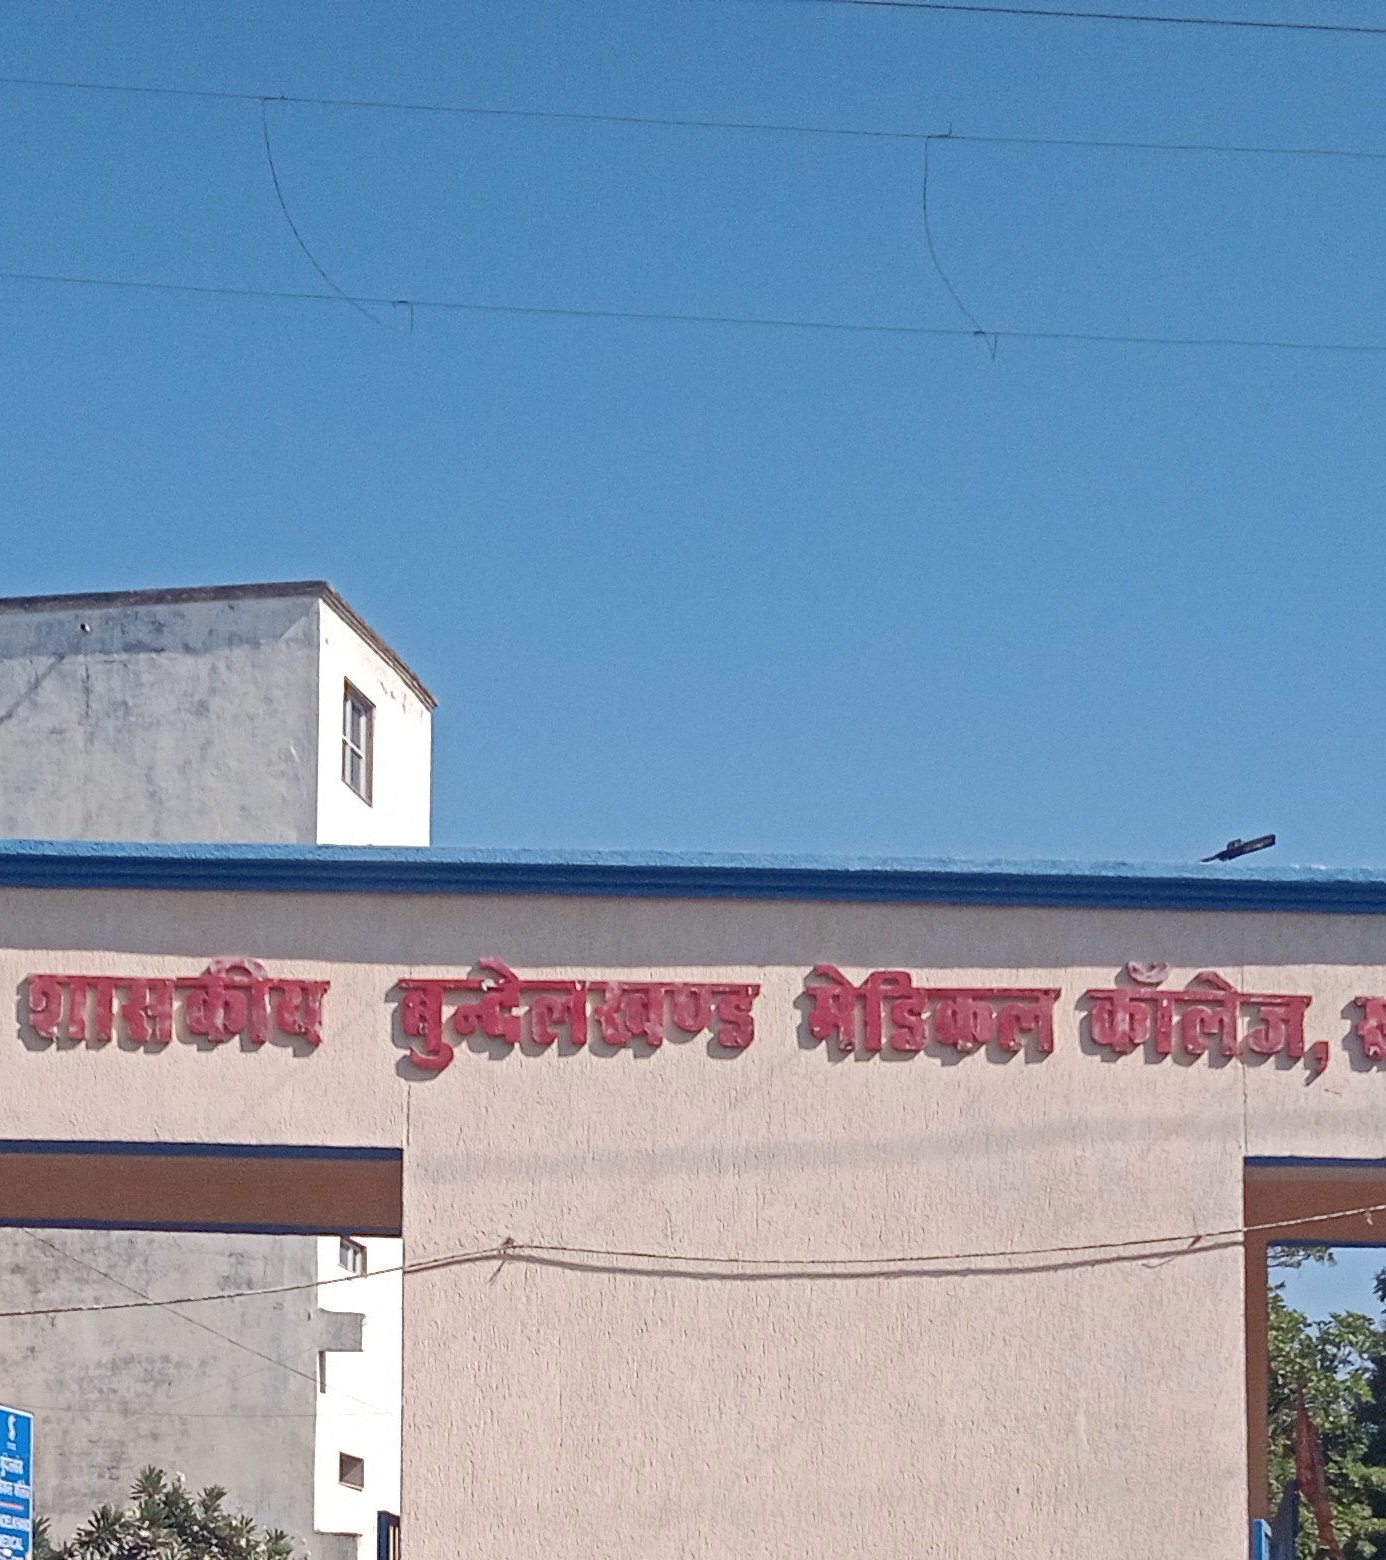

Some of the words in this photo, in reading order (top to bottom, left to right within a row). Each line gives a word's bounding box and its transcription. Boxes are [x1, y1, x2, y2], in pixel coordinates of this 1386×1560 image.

[27, 956, 331, 1046] शासकीय
[393, 957, 762, 1070] बुन्देलखण्ड
[804, 963, 1062, 1052] मेडिकल
